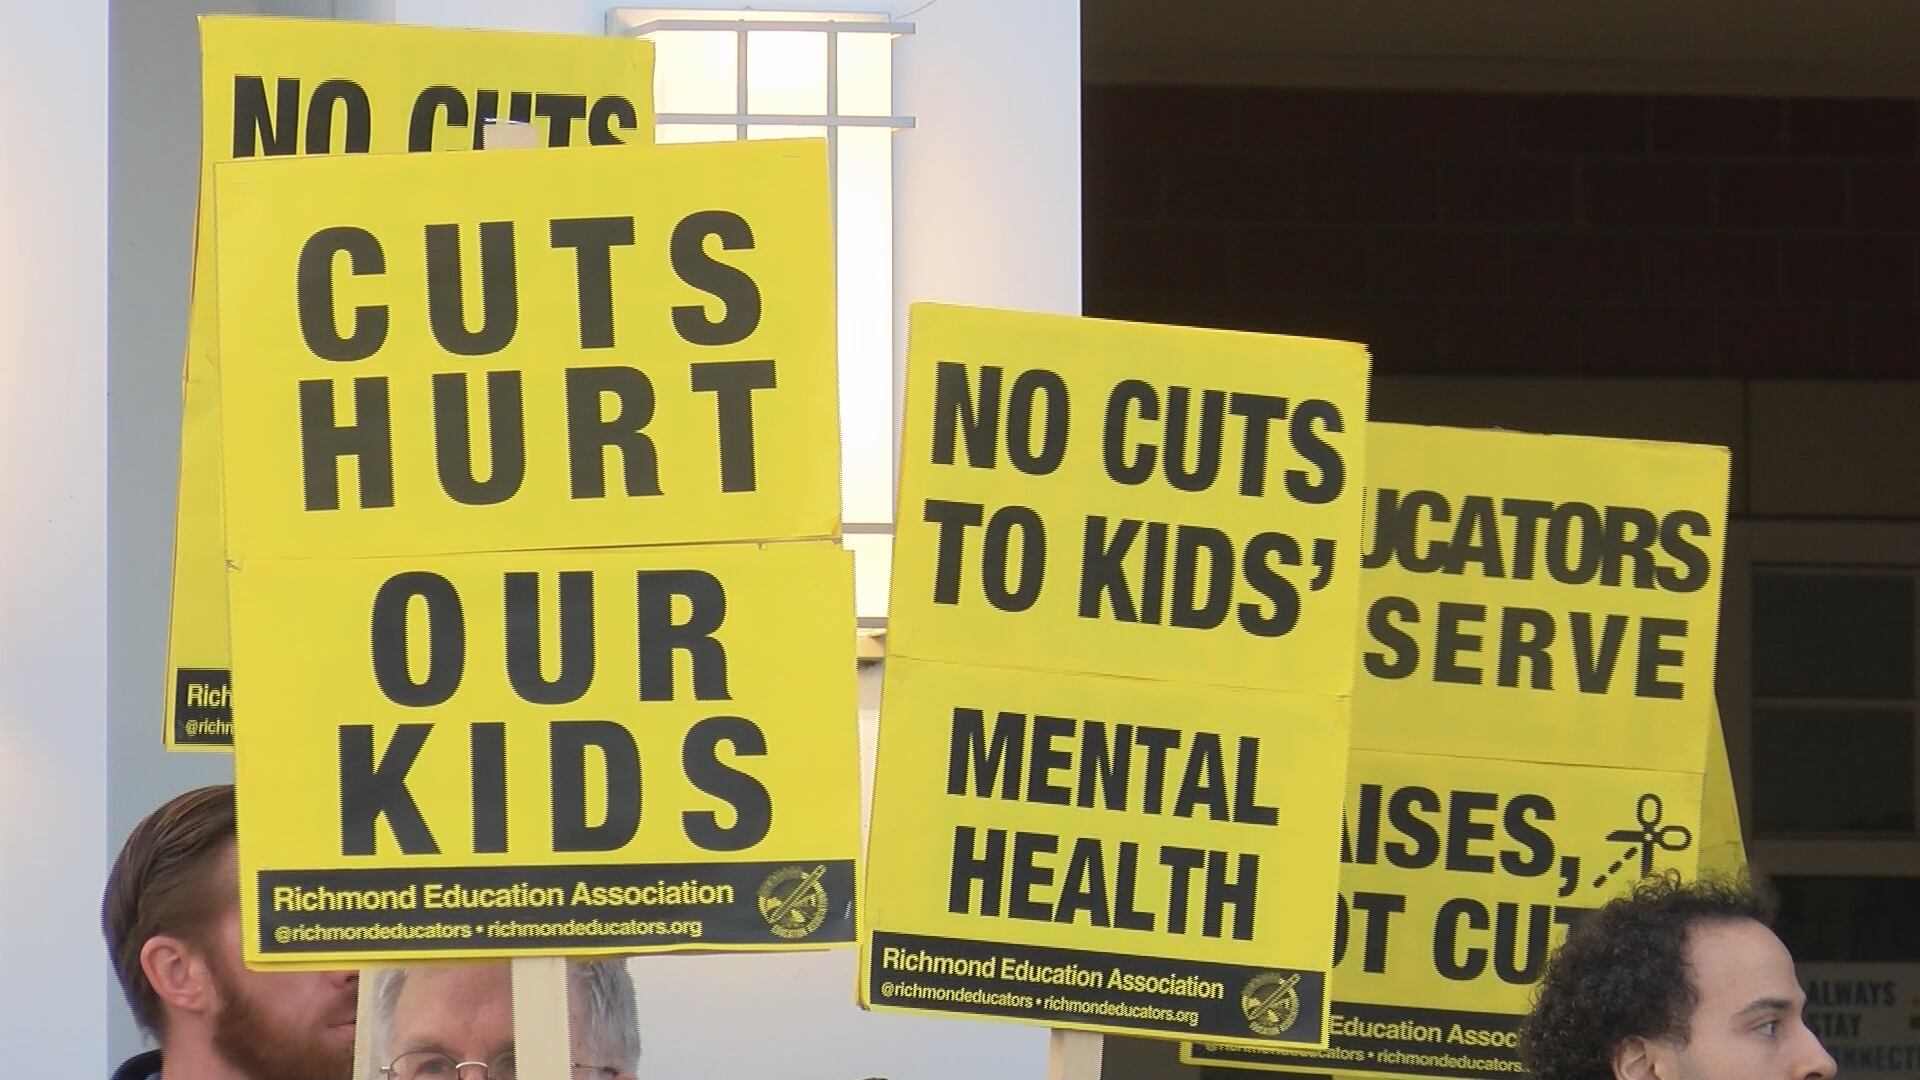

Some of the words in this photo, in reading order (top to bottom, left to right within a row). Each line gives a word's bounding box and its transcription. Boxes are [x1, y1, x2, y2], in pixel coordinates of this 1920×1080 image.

[233, 75, 371, 158] NO
[297, 210, 763, 362] CUTS
[298, 360, 777, 512] HURT
[931, 361, 1071, 476] NO
[1102, 378, 1347, 504] CUTS
[923, 498, 1047, 613] TO
[1077, 514, 1337, 638] KIDS'
[370, 569, 734, 707] OUR
[1363, 595, 1689, 700] SERVE
[338, 716, 773, 856] KIDS
[946, 707, 1280, 827] MENTAL
[273, 886, 417, 911] Richmond
[423, 882, 565, 909] Education
[571, 879, 735, 906] Association
[274, 922, 472, 944] @richmondeducators
[487, 918, 703, 938] richmondeducators.org
[948, 825, 1260, 942] HEALTH
[1333, 891, 1406, 974] T
[881, 981, 1034, 1009] @richmondeducators
[1044, 995, 1199, 1027] richmondeducators.org
[882, 947, 996, 979] Richmond
[1000, 957, 1102, 989] Education
[1107, 967, 1225, 999] Association
[1807, 980, 1896, 1007] ALWAYS
[1331, 1014, 1442, 1043] Education
